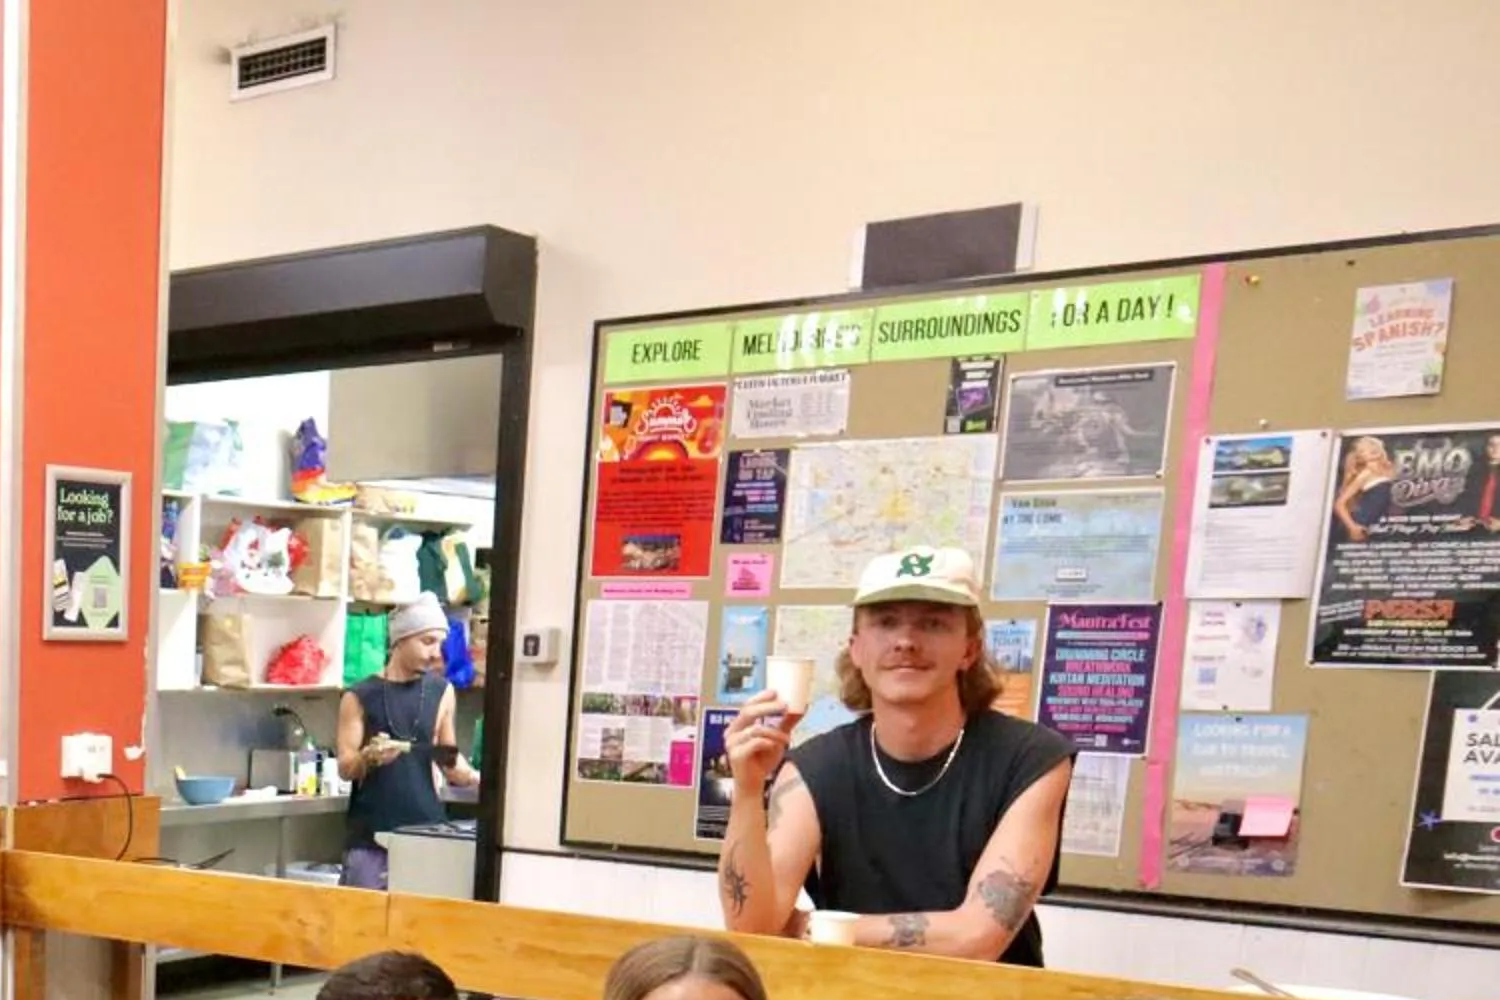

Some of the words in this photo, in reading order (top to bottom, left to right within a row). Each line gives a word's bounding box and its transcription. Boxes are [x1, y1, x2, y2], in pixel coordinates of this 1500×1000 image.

[631, 338, 704, 365] EXPLORE
[877, 309, 1022, 344] SURROUNDINGS
[1096, 300, 1111, 325] A
[1116, 294, 1161, 321] DAY
[59, 487, 110, 508] Looking
[57, 508, 77, 522] for
[78, 511, 86, 522] a
[86, 508, 114, 526] job?
[1058, 611, 1153, 629] MantraFest
[1110, 648, 1146, 661] CIRCLE
[1085, 673, 1146, 686] MEDITATION
